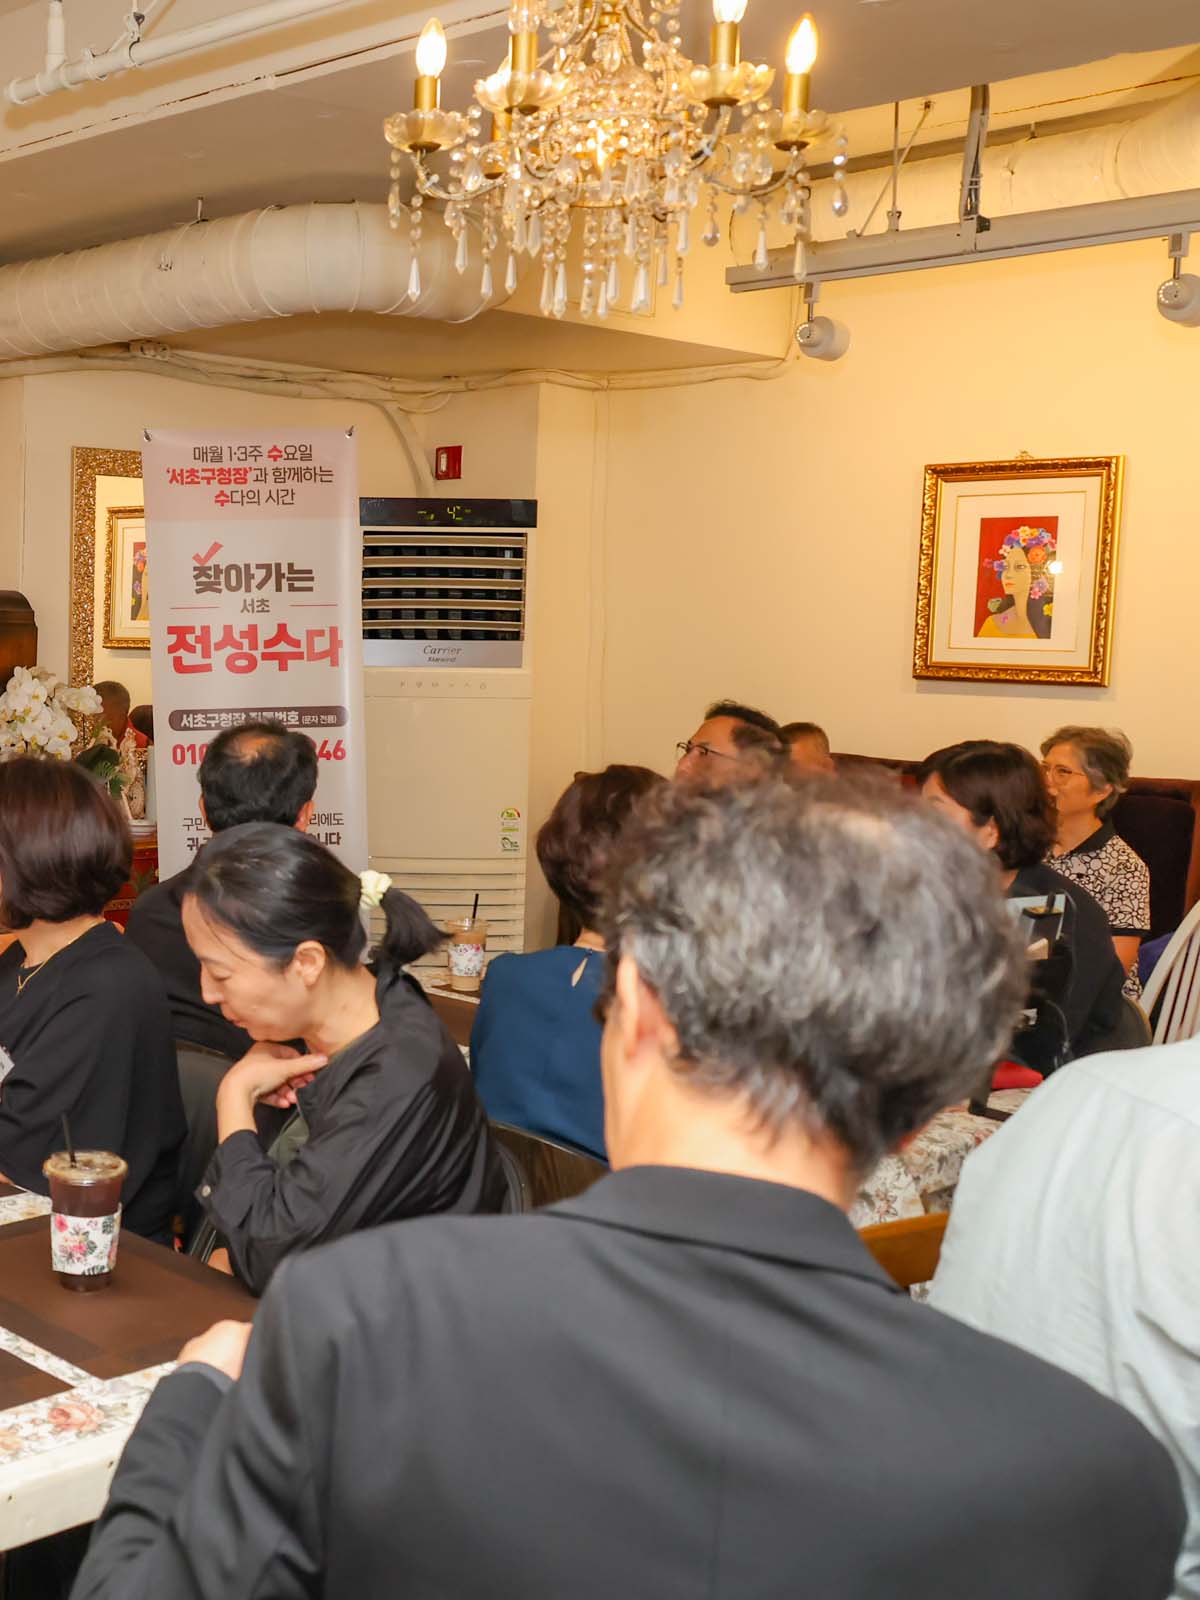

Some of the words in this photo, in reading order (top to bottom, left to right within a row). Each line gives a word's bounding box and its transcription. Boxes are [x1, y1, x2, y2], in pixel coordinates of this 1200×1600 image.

[193, 446, 224, 463] 매월
[267, 444, 313, 462] 수요일
[272, 466, 334, 484] 함께하는
[214, 489, 260, 507] 수다의
[265, 489, 296, 506] 시간
[192, 562, 315, 594] 찾아가는
[240, 598, 271, 614] 서초
[166, 623, 344, 674] 전성수다
[180, 712, 247, 728] 서초구청장
